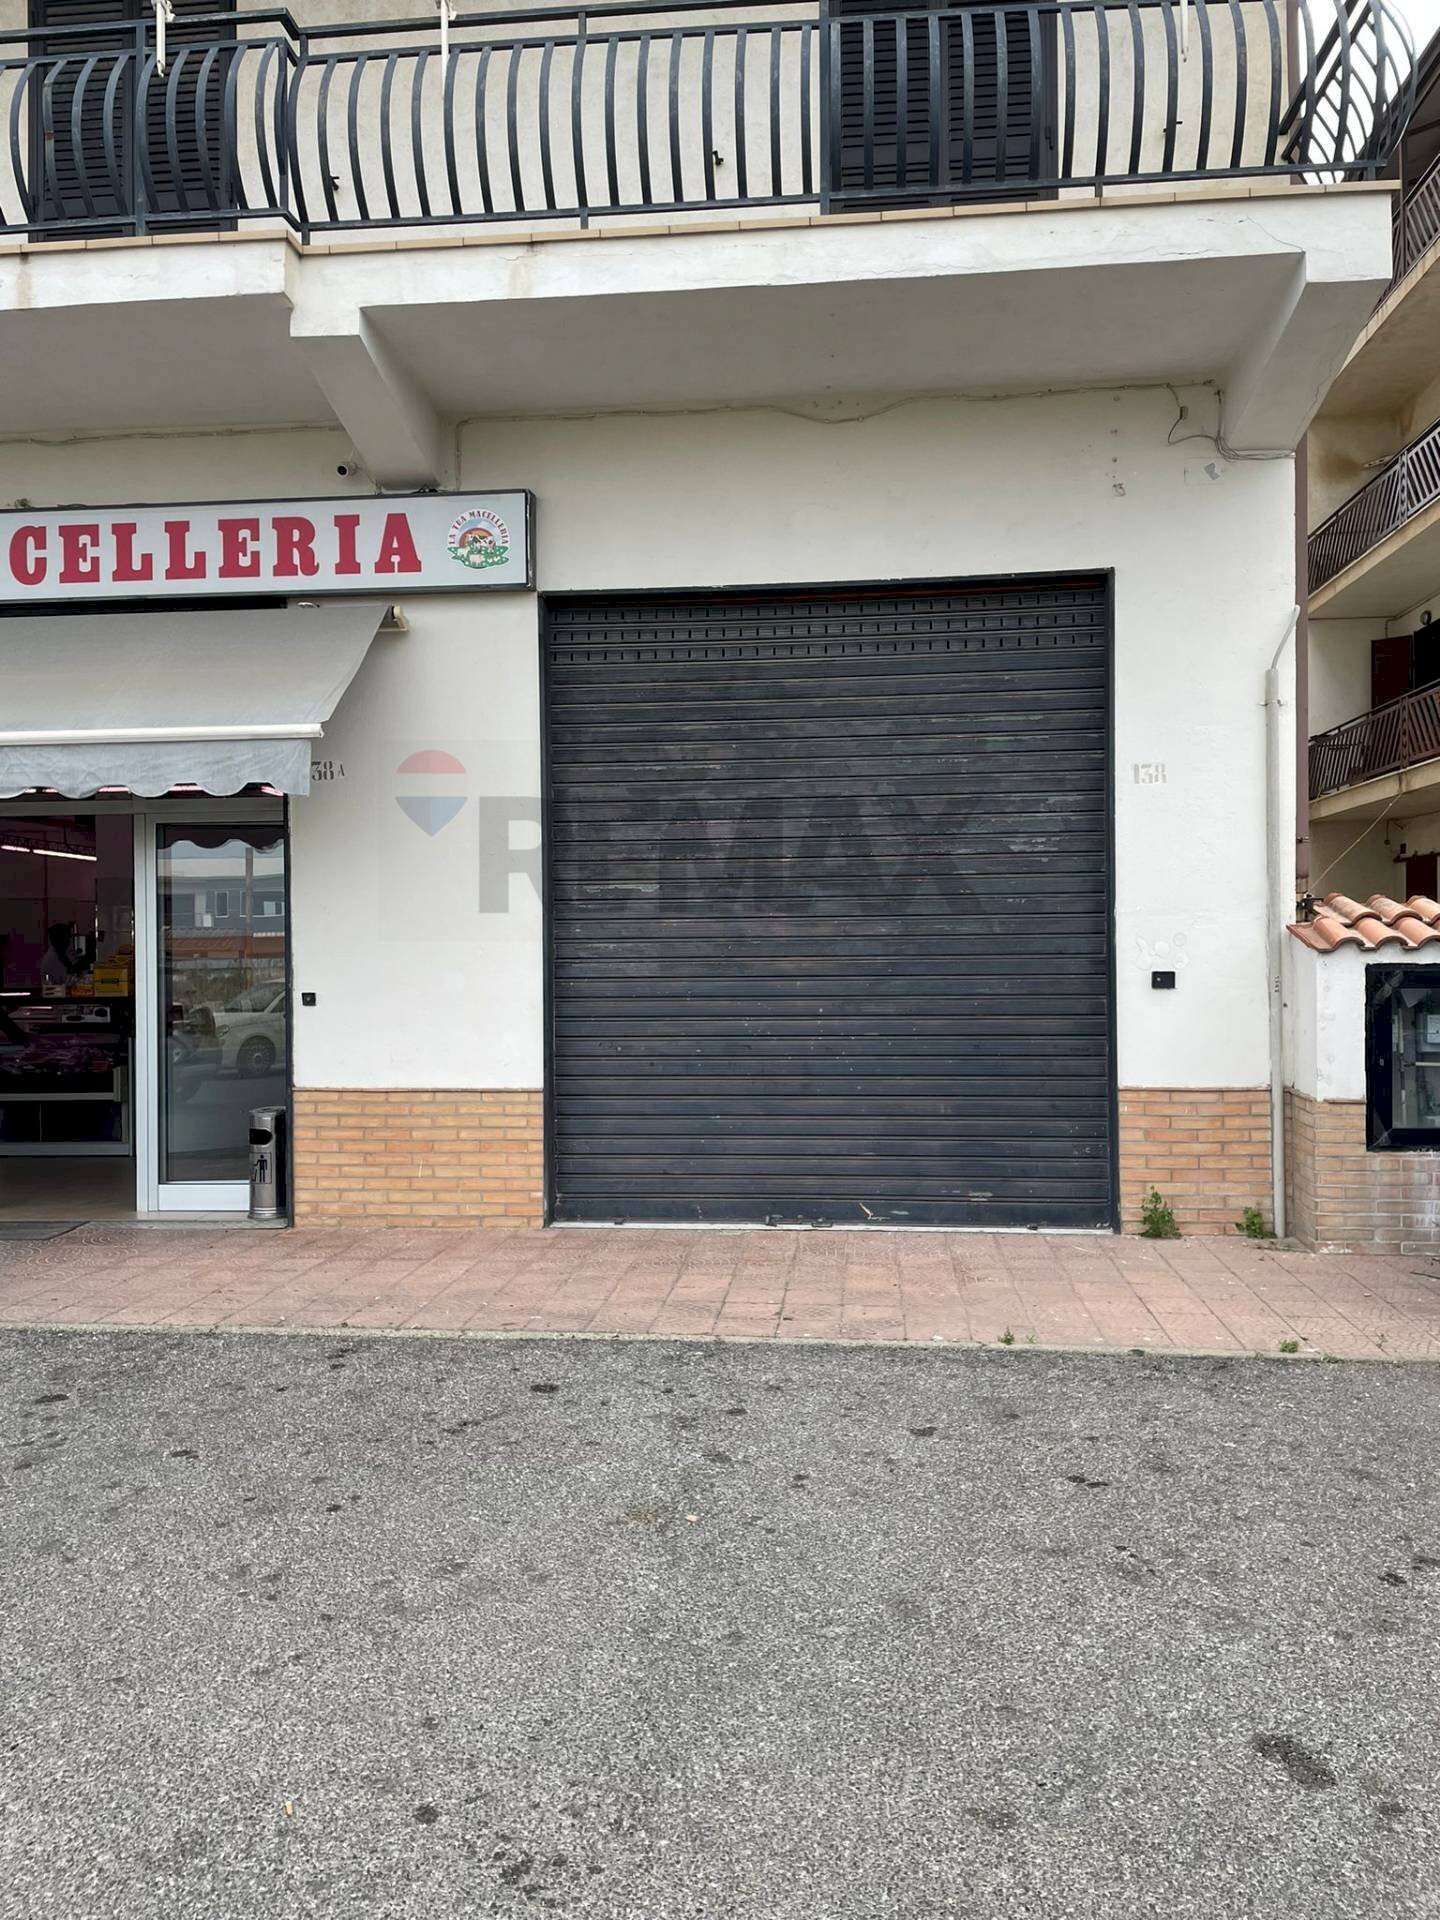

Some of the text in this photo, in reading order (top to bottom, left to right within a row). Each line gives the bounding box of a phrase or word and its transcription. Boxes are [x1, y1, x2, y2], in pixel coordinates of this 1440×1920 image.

[9, 512, 422, 586] CELLERIA
[452, 515, 467, 530] TUA
[469, 510, 509, 545] MACELLERIA
